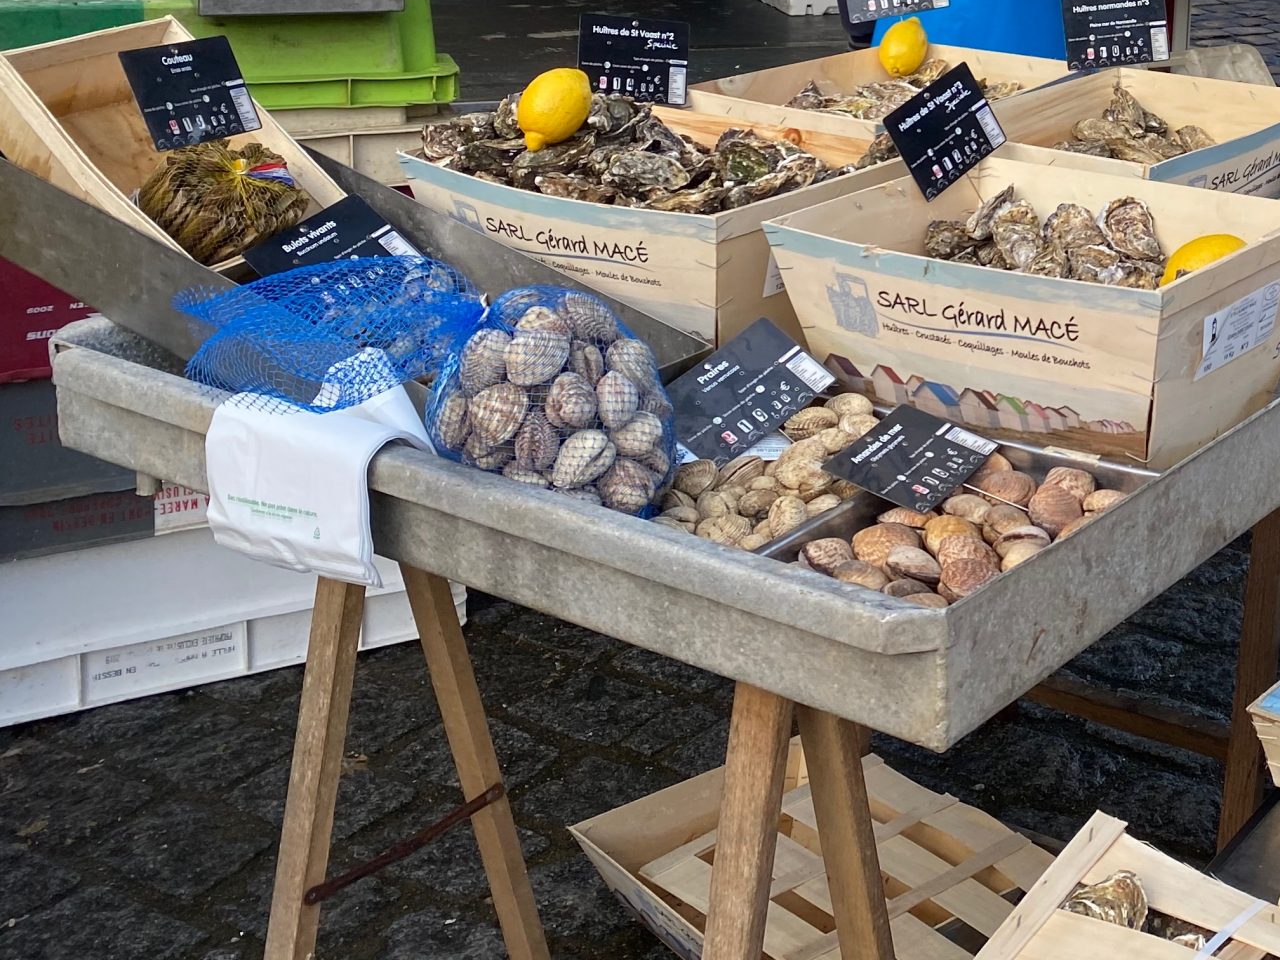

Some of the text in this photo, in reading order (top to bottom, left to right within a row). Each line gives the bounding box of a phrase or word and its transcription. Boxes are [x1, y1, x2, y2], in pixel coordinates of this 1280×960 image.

[1098, 0, 1137, 11] normandes
[620, 27, 630, 37] de
[630, 29, 639, 37] St
[640, 30, 661, 39] Vaast
[161, 53, 193, 66] Couteau
[1211, 169, 1241, 191] SARL
[281, 220, 337, 254] Bulots vivants
[485, 217, 649, 263] SARL Gérard MACÉ
[595, 269, 620, 281] Moules
[877, 290, 1079, 342] SARL Gérard MACÉ
[881, 321, 911, 337] Huîtres
[957, 338, 1005, 356] Coquillages
[1011, 349, 1040, 363] Moules
[1041, 352, 1051, 363] de
[1052, 355, 1092, 370] Bouchots
[696, 360, 730, 385] Praires
[717, 365, 741, 383] verrucosa
[851, 439, 883, 465] Amandes
